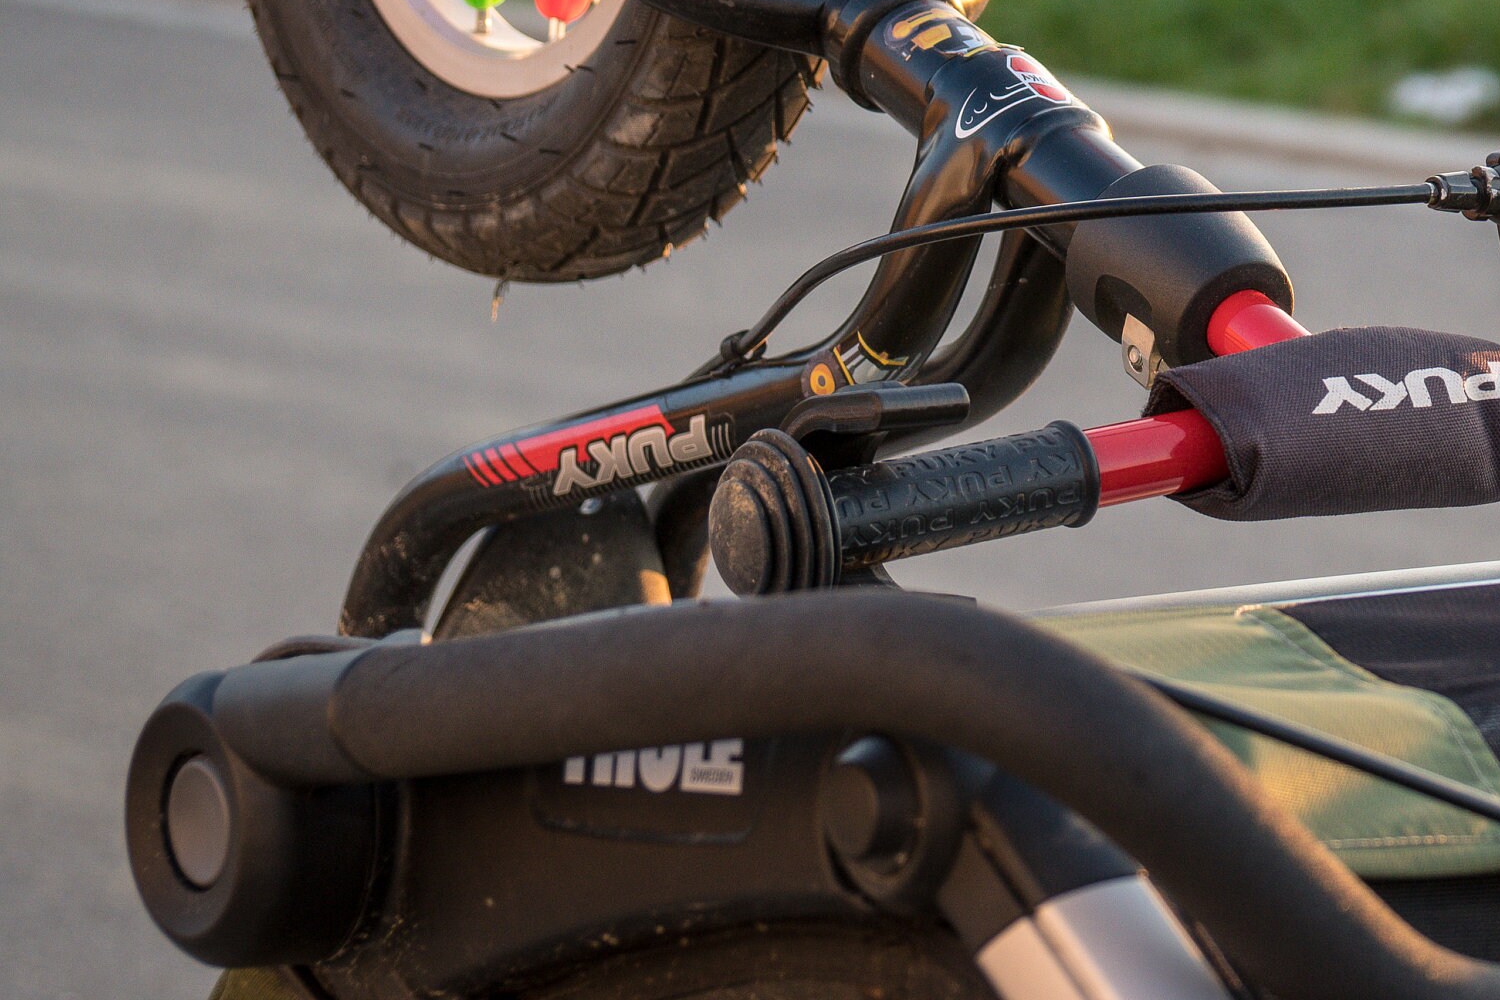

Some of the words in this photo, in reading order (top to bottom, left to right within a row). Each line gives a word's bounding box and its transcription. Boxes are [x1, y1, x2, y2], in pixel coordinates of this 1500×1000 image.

[553, 414, 713, 496] PUKY
[903, 464, 1014, 511] PUKY
[969, 479, 1082, 525] PUKY
[841, 507, 954, 550] PUKY
